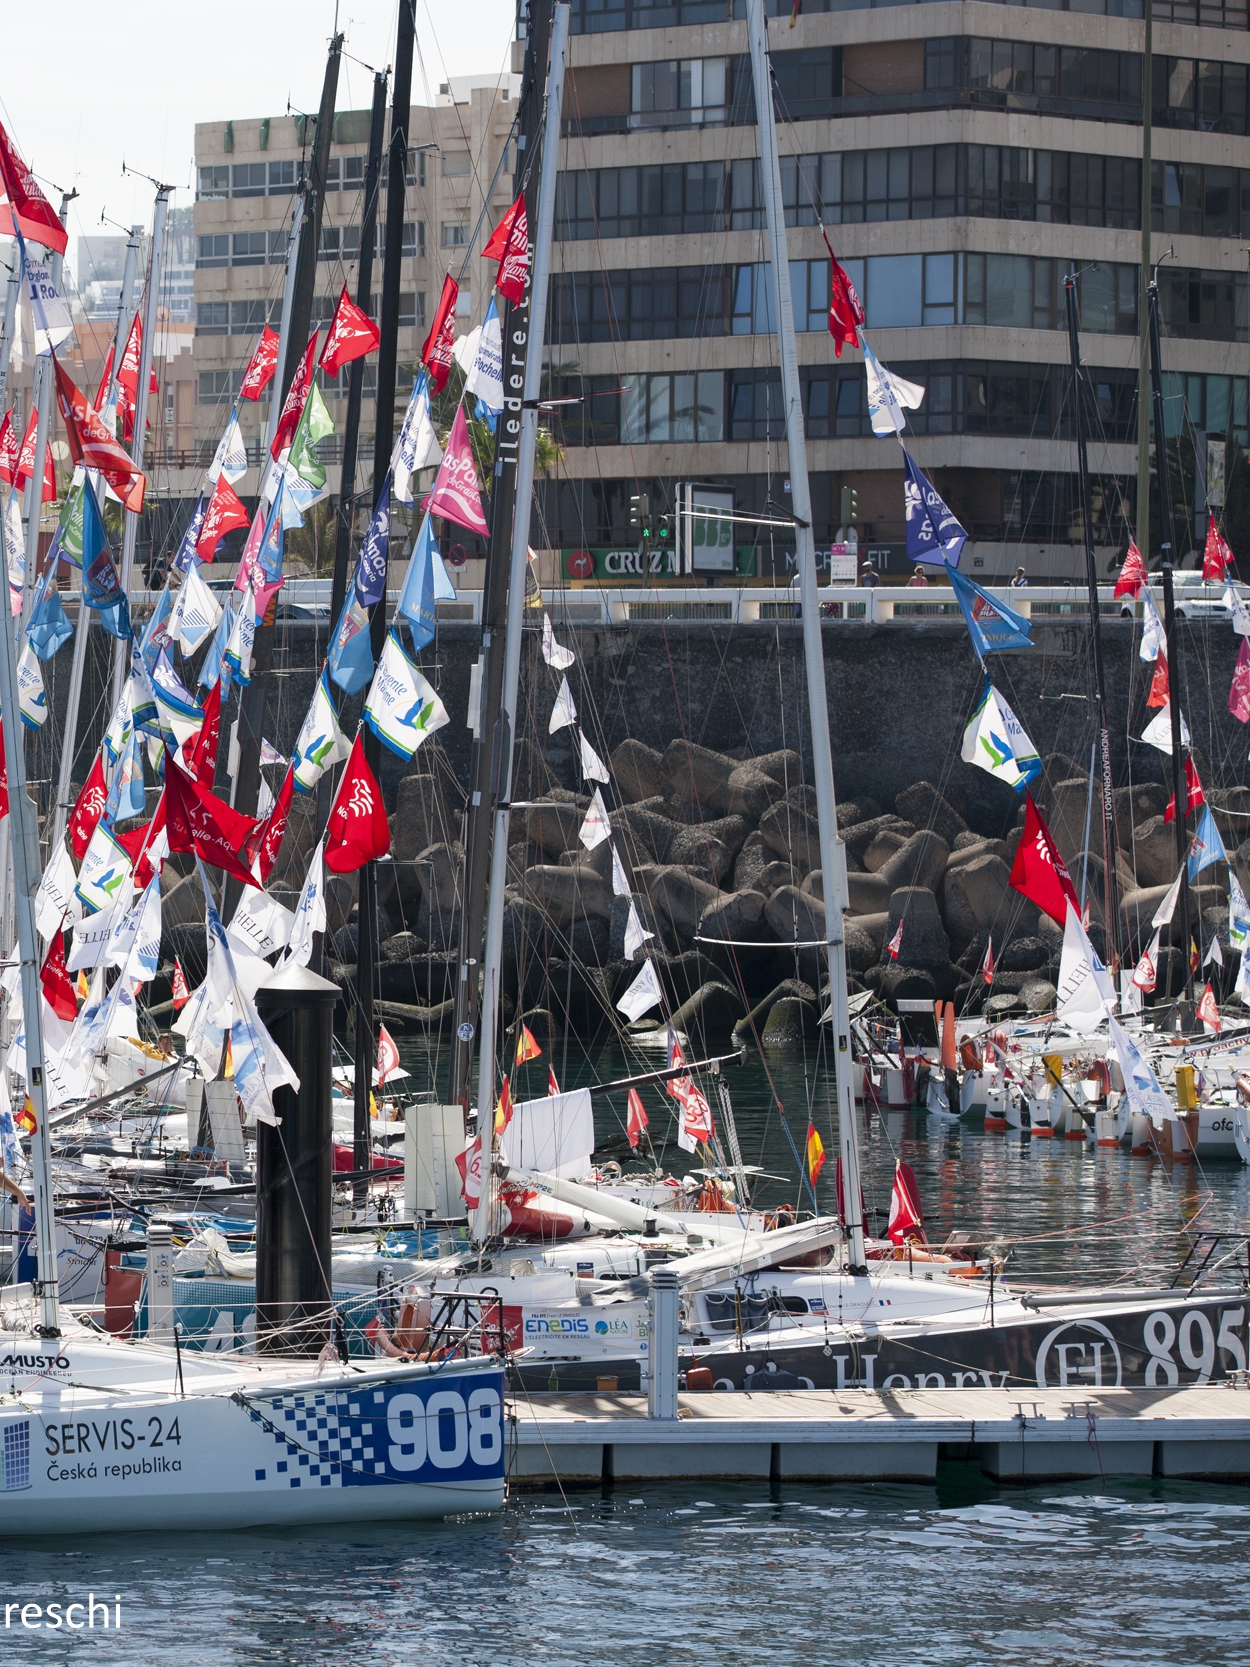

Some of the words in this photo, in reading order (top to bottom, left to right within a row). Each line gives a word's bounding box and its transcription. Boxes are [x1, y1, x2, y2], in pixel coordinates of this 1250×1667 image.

[604, 551, 664, 574] CRUZ
[609, 1318, 629, 1330] LÉA
[1143, 1304, 1249, 1388] 895
[0, 1355, 70, 1370] MUSTO
[45, 1415, 182, 1457] SERVIS-24
[386, 1386, 502, 1473] 908
[46, 1460, 98, 1482] Česká
[104, 1456, 182, 1480] republika
